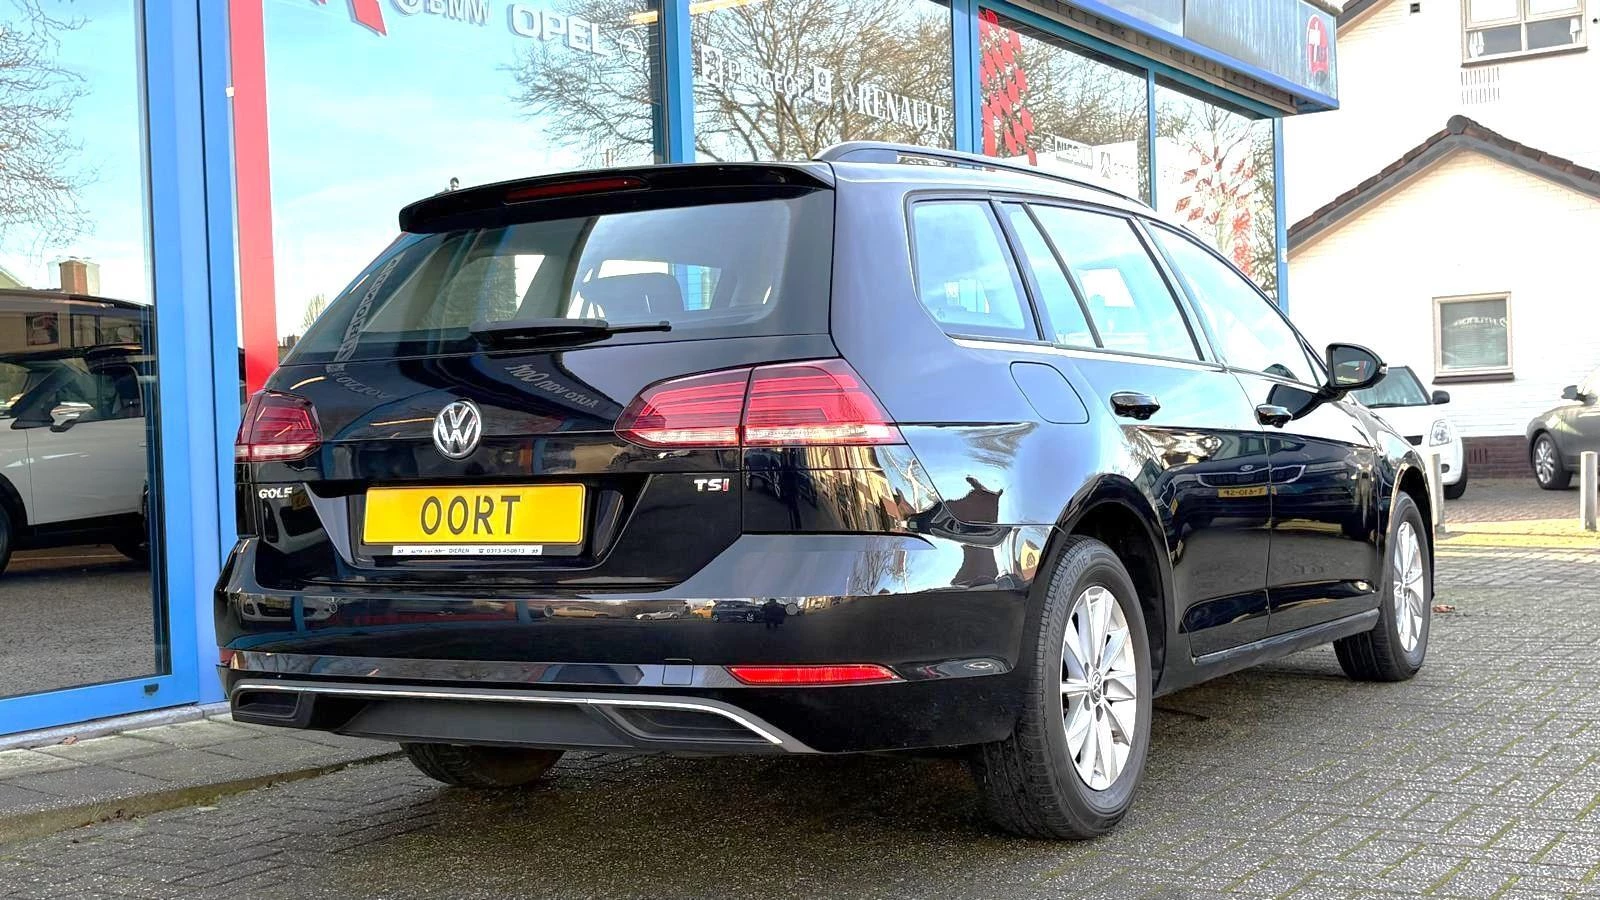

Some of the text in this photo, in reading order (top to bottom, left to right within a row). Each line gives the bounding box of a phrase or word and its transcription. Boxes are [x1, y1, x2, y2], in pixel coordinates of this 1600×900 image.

[510, 4, 615, 57] OPEL
[729, 60, 806, 97] PEUGEOT
[858, 83, 946, 134] RENAULT
[258, 486, 293, 499] GOLF
[420, 494, 521, 536] OORT
